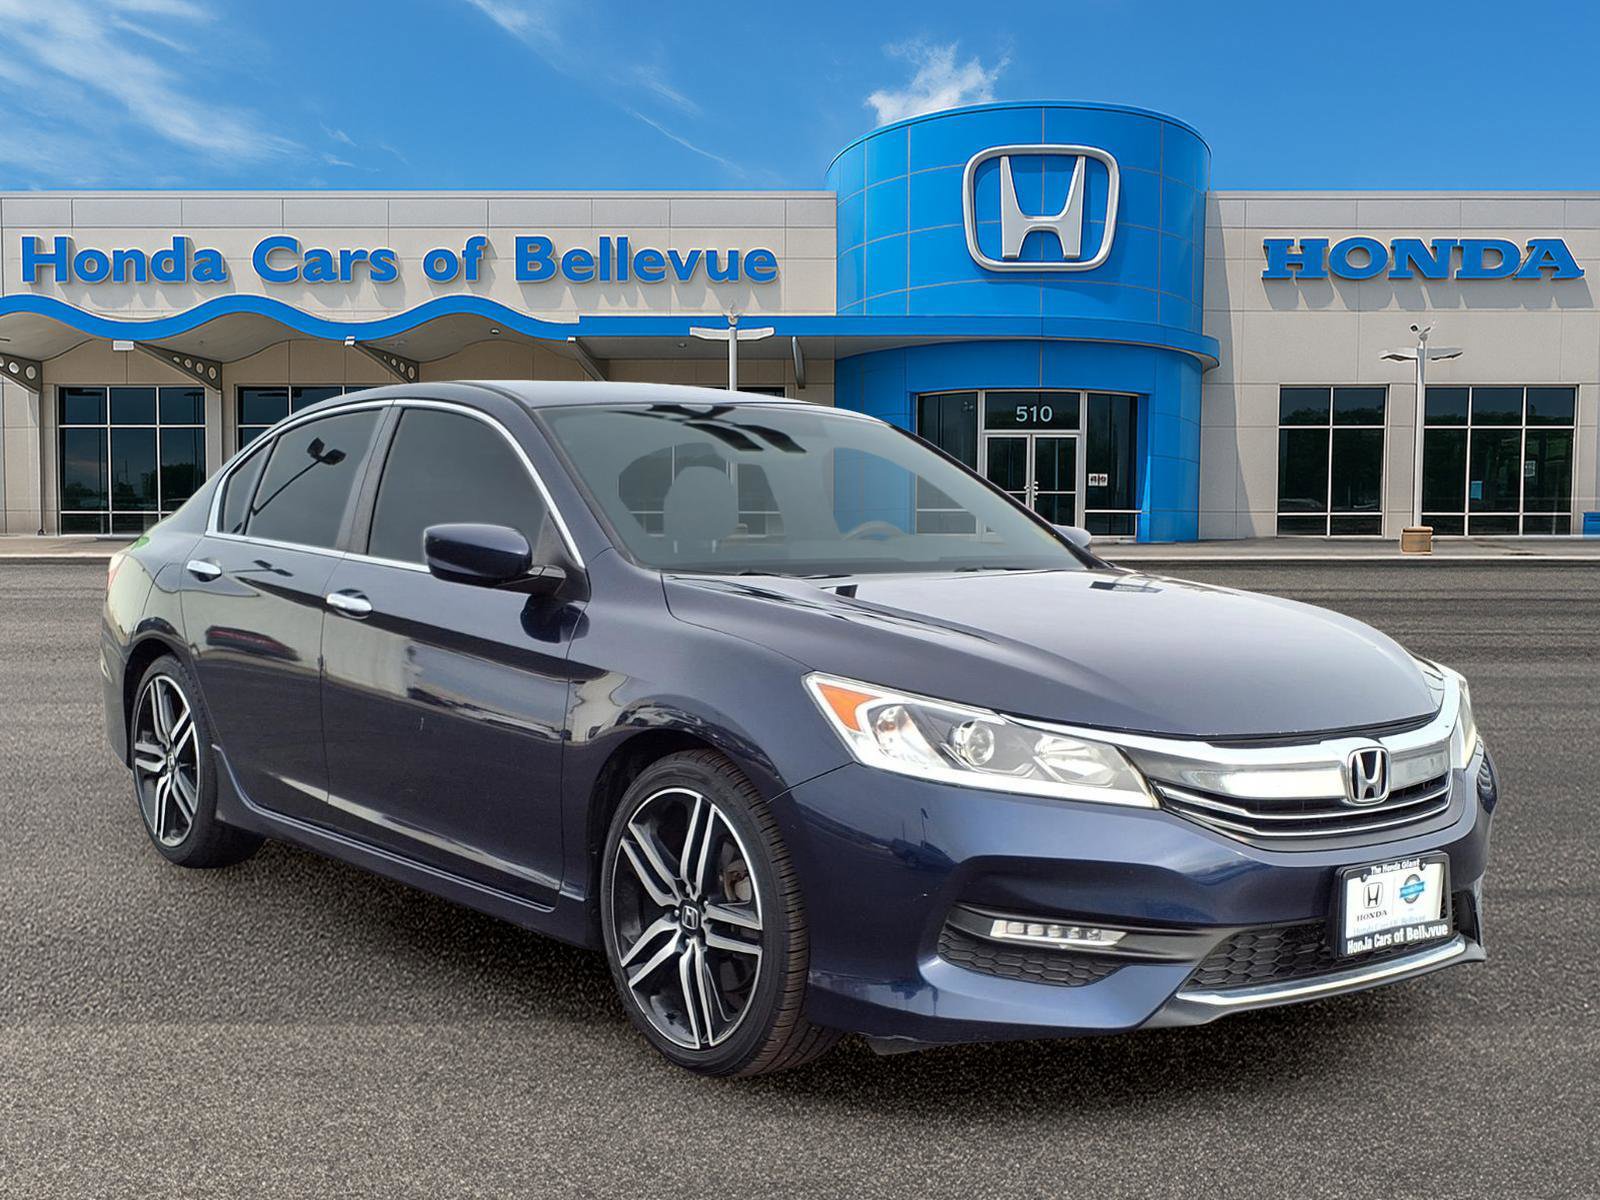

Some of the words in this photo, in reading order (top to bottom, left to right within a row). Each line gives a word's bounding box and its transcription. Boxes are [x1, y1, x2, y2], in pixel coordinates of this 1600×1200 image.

[20, 234, 229, 284] Honda
[251, 234, 400, 284] Cars
[421, 233, 489, 284] of
[514, 234, 779, 284] Bellevue
[1261, 235, 1586, 280] HONDA
[1015, 405, 1053, 422] 510
[1357, 910, 1387, 922] HONDA
[1374, 933, 1392, 948] Cars
[1394, 927, 1404, 942] of
